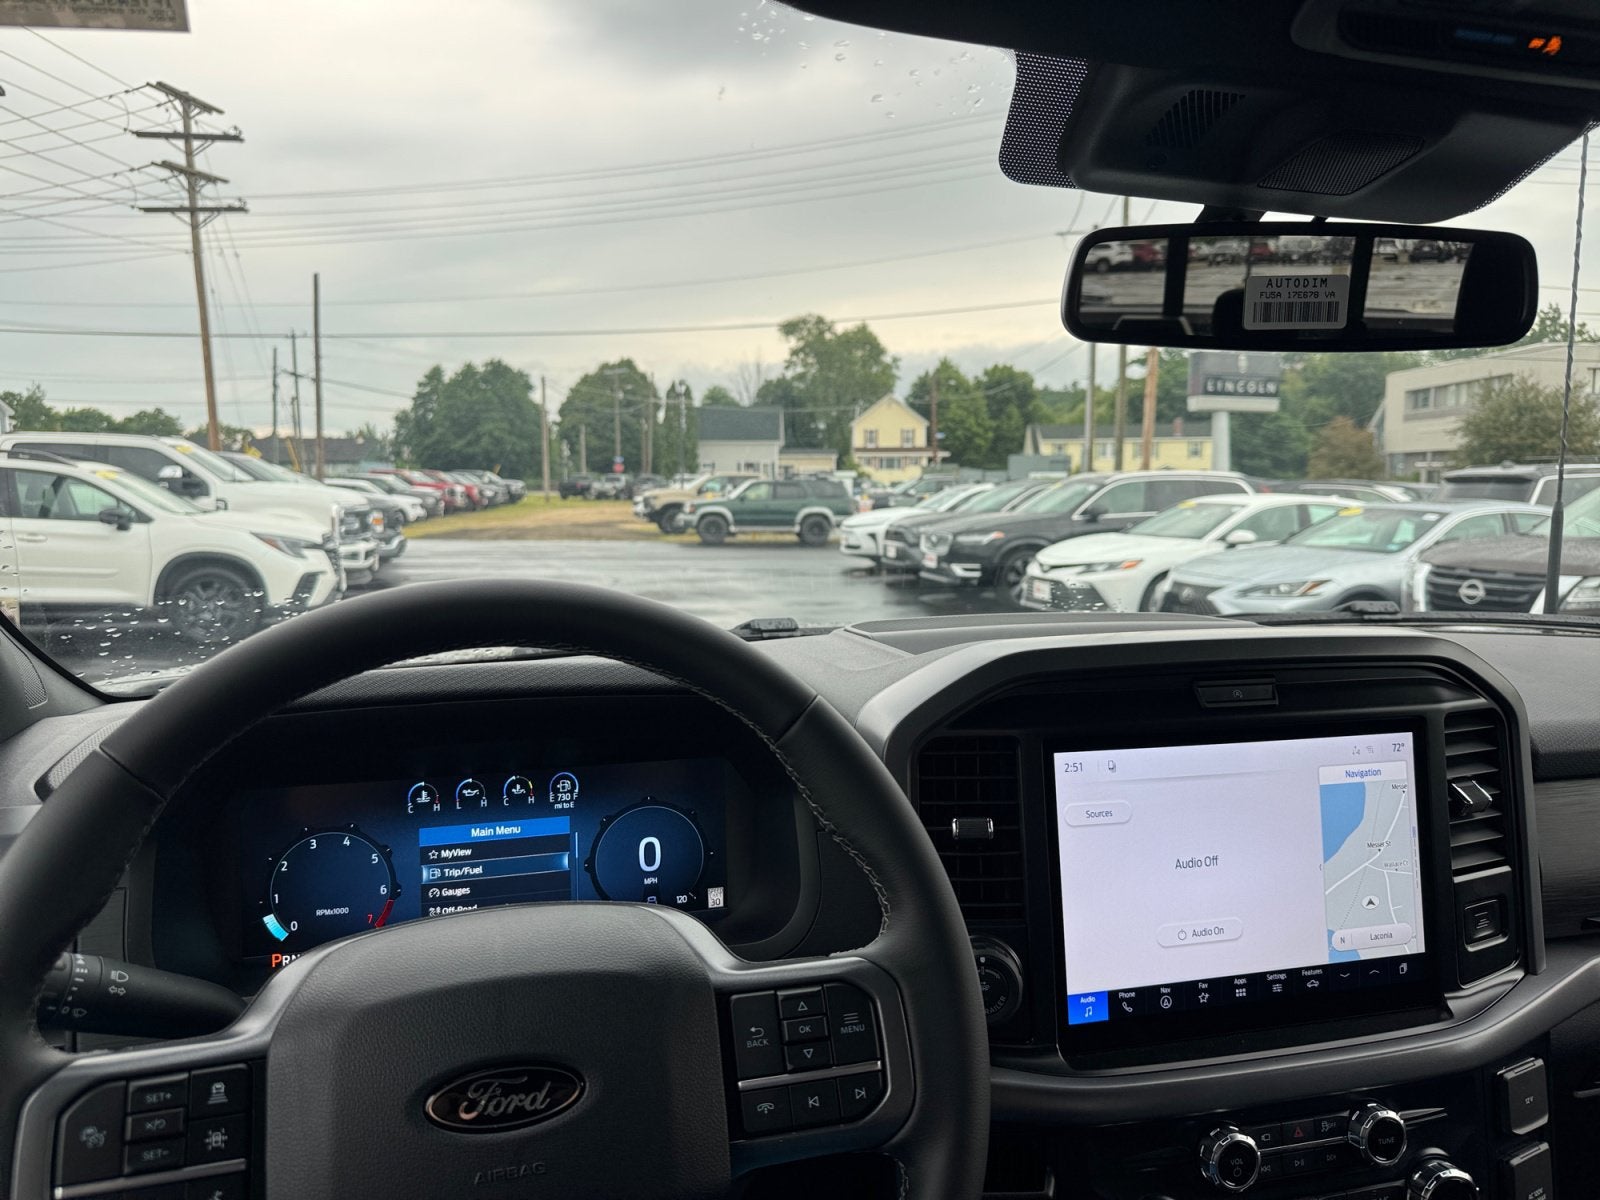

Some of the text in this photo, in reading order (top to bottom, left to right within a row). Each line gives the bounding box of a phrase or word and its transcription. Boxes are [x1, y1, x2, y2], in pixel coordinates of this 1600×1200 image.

[1266, 277, 1328, 288] AUTODIM
[1287, 291, 1320, 299] 17E678
[1324, 291, 1336, 299] VA
[1206, 379, 1277, 394] LINCOLN
[1064, 762, 1083, 773] 2:51
[1345, 766, 1382, 779] Navigation
[503, 797, 510, 806] C
[528, 796, 535, 804] H
[557, 793, 571, 801] 730
[572, 792, 579, 800] F
[433, 803, 441, 812] H
[456, 801, 462, 810] L
[480, 799, 488, 807] H
[554, 802, 562, 810] mi
[1085, 808, 1113, 819] Sources
[471, 825, 521, 837] Main Menu
[309, 839, 317, 849] 3
[343, 836, 350, 846] 4
[371, 853, 379, 864] 5
[440, 848, 472, 859] MyView
[638, 836, 662, 872] 0
[281, 861, 288, 871] 2
[1175, 855, 1219, 870] Audio Off
[444, 865, 483, 877] Trip/Fuel
[644, 877, 658, 885] MPH
[380, 885, 387, 895] 6
[441, 886, 471, 897] Gauges
[274, 894, 279, 904] 1
[676, 895, 688, 904] 120
[710, 898, 721, 907] 30
[315, 907, 350, 917] RPMx1000
[367, 914, 373, 924] 7
[290, 921, 298, 931] 0
[1191, 926, 1225, 938] Audio On
[1369, 931, 1393, 941] Laconia
[1340, 937, 1345, 945] N
[1266, 972, 1287, 982] Settings
[1301, 967, 1323, 977] Features
[1198, 981, 1208, 990] Fav
[1234, 977, 1247, 986] Apps
[1118, 990, 1136, 999] Phone
[1160, 986, 1171, 995] Nav
[1080, 995, 1096, 1004] Audio
[799, 1024, 812, 1033] OK
[840, 1024, 865, 1034] MENU
[746, 1038, 769, 1049] BACK
[459, 1075, 552, 1120] Ford
[1377, 1136, 1395, 1146] TUNE
[1230, 1158, 1243, 1166] VOL
[474, 1162, 546, 1185] AIRBAG
